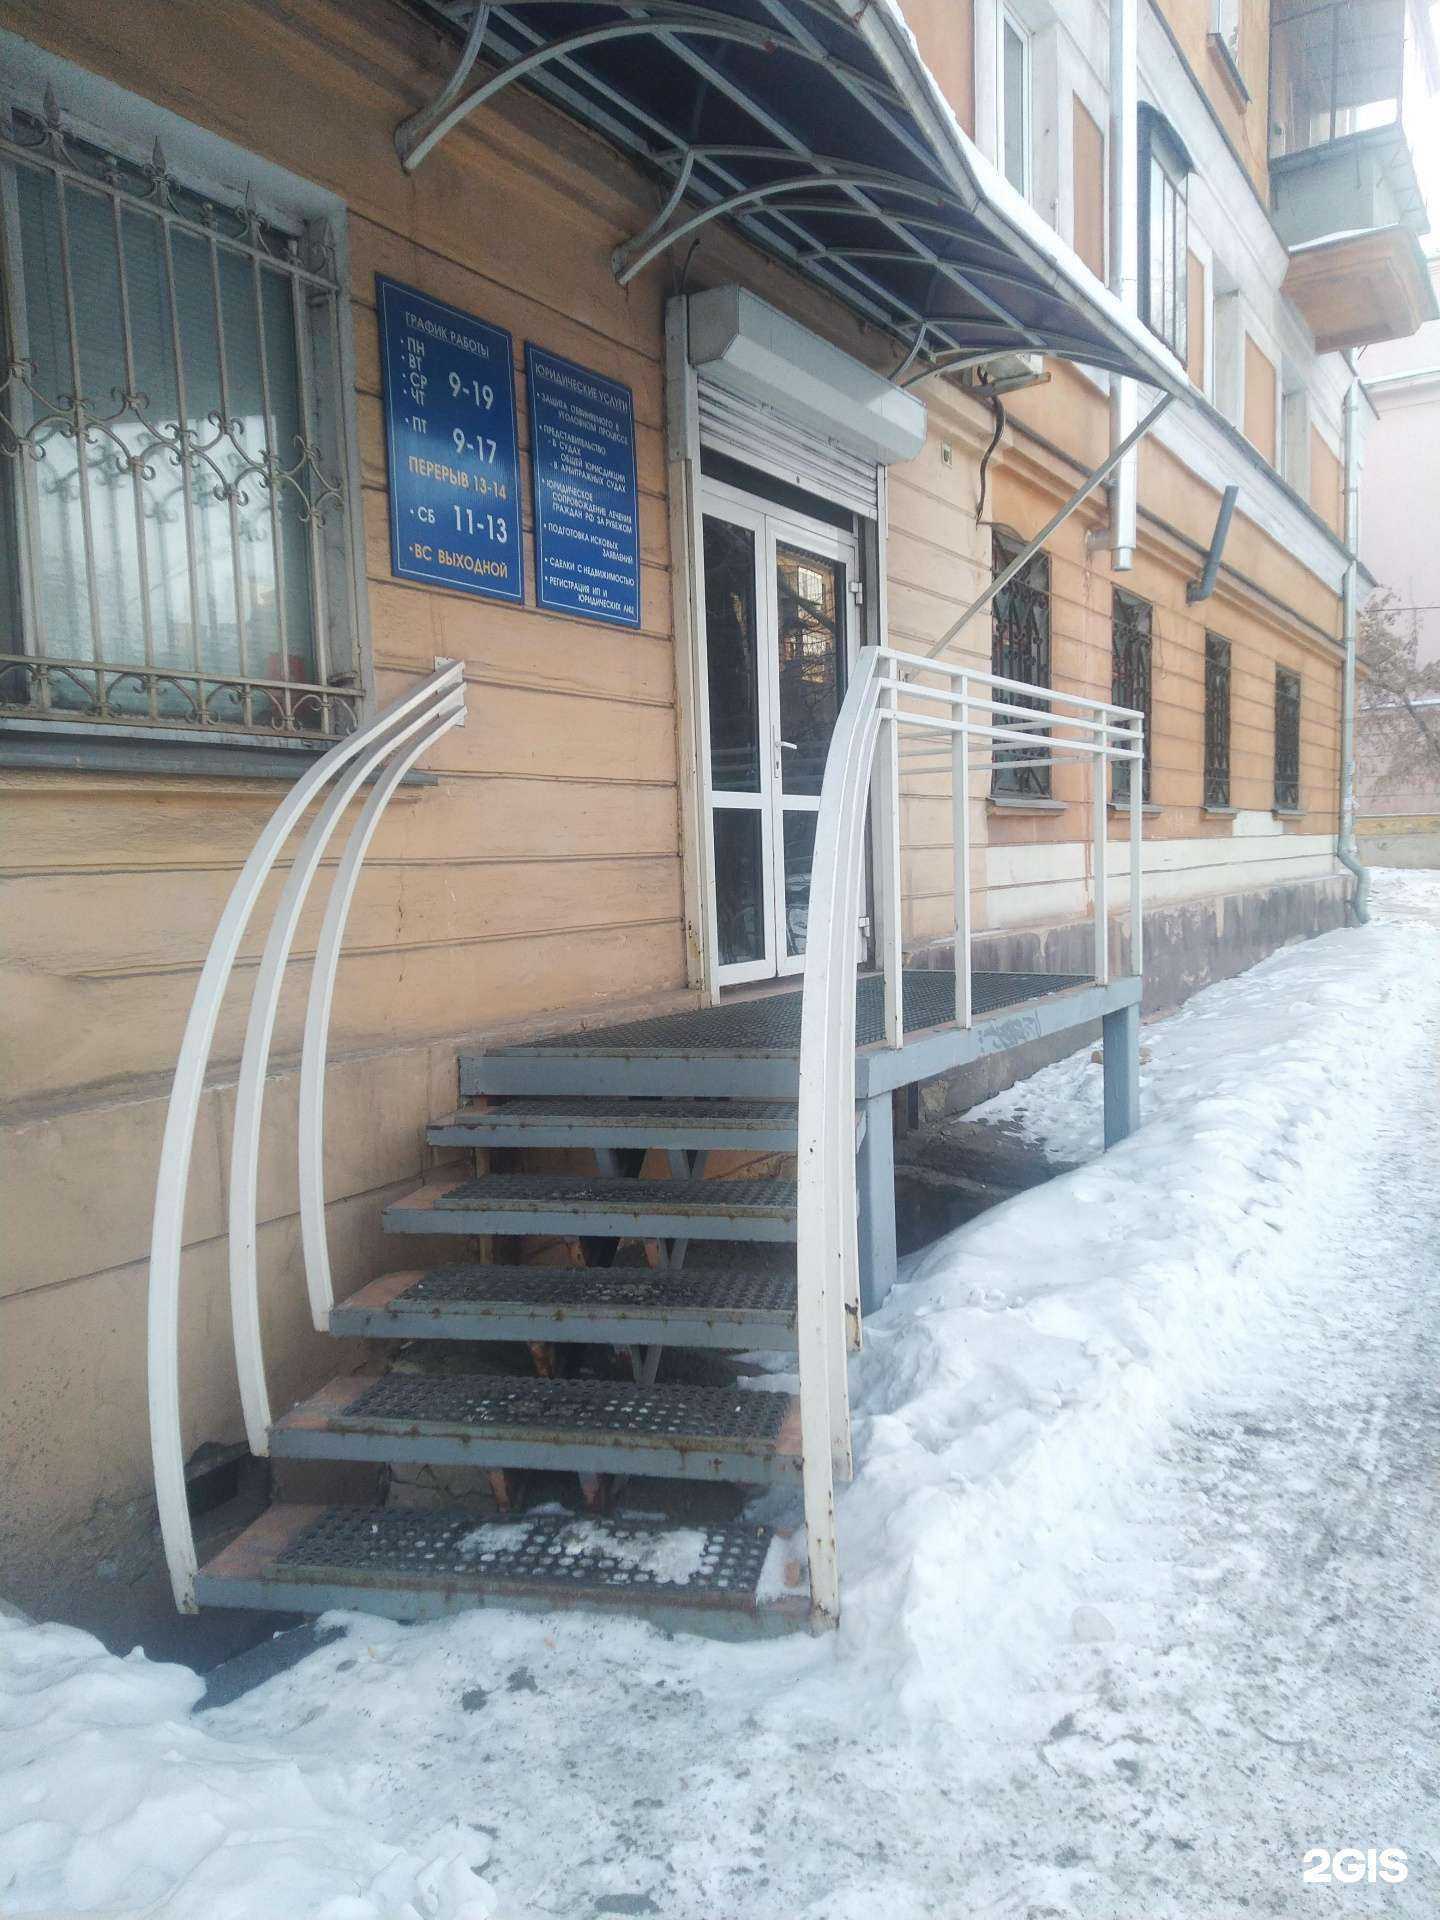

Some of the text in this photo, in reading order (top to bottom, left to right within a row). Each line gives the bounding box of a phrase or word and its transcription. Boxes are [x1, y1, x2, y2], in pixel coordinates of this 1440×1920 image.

[405, 311, 489, 358] ГРАФИК РАБОТЫ
[407, 337, 425, 357] ПН
[408, 353, 423, 371] ВТ
[410, 372, 428, 389] СР
[448, 371, 494, 410] 9-19
[536, 363, 598, 400] ЮРИДИЧЕСКИЕ
[411, 387, 425, 407] ЧТ
[412, 416, 427, 434] ПТ
[453, 428, 497, 465] 9-17
[408, 455, 507, 500] ПЕРЕРЫВ 13-14
[546, 479, 593, 502] ЮРИДИЧЕСКОЕ
[417, 506, 436, 525] СБ
[552, 491, 607, 516] СОПРОВОЖДЕНИЕ
[453, 504, 508, 544] 11-13
[552, 503, 583, 519] ГРАЖДАН
[585, 511, 595, 523] РФ
[605, 519, 633, 535] РУБЕЖОМ
[548, 522, 619, 552] ПОДГОТОВКА ИСКОВЫХ
[414, 543, 508, 579] ВС ВЫХОДНОЙ
[549, 556, 575, 571] СДЕЛКИ
[583, 566, 635, 587] НЕДВИЖИМОСТЬЮ
[549, 576, 590, 594] РЕГИСТРАЦИЯ
[592, 586, 601, 597] ИП
[578, 593, 621, 611] ЮРИДИЧЕСКИХ
